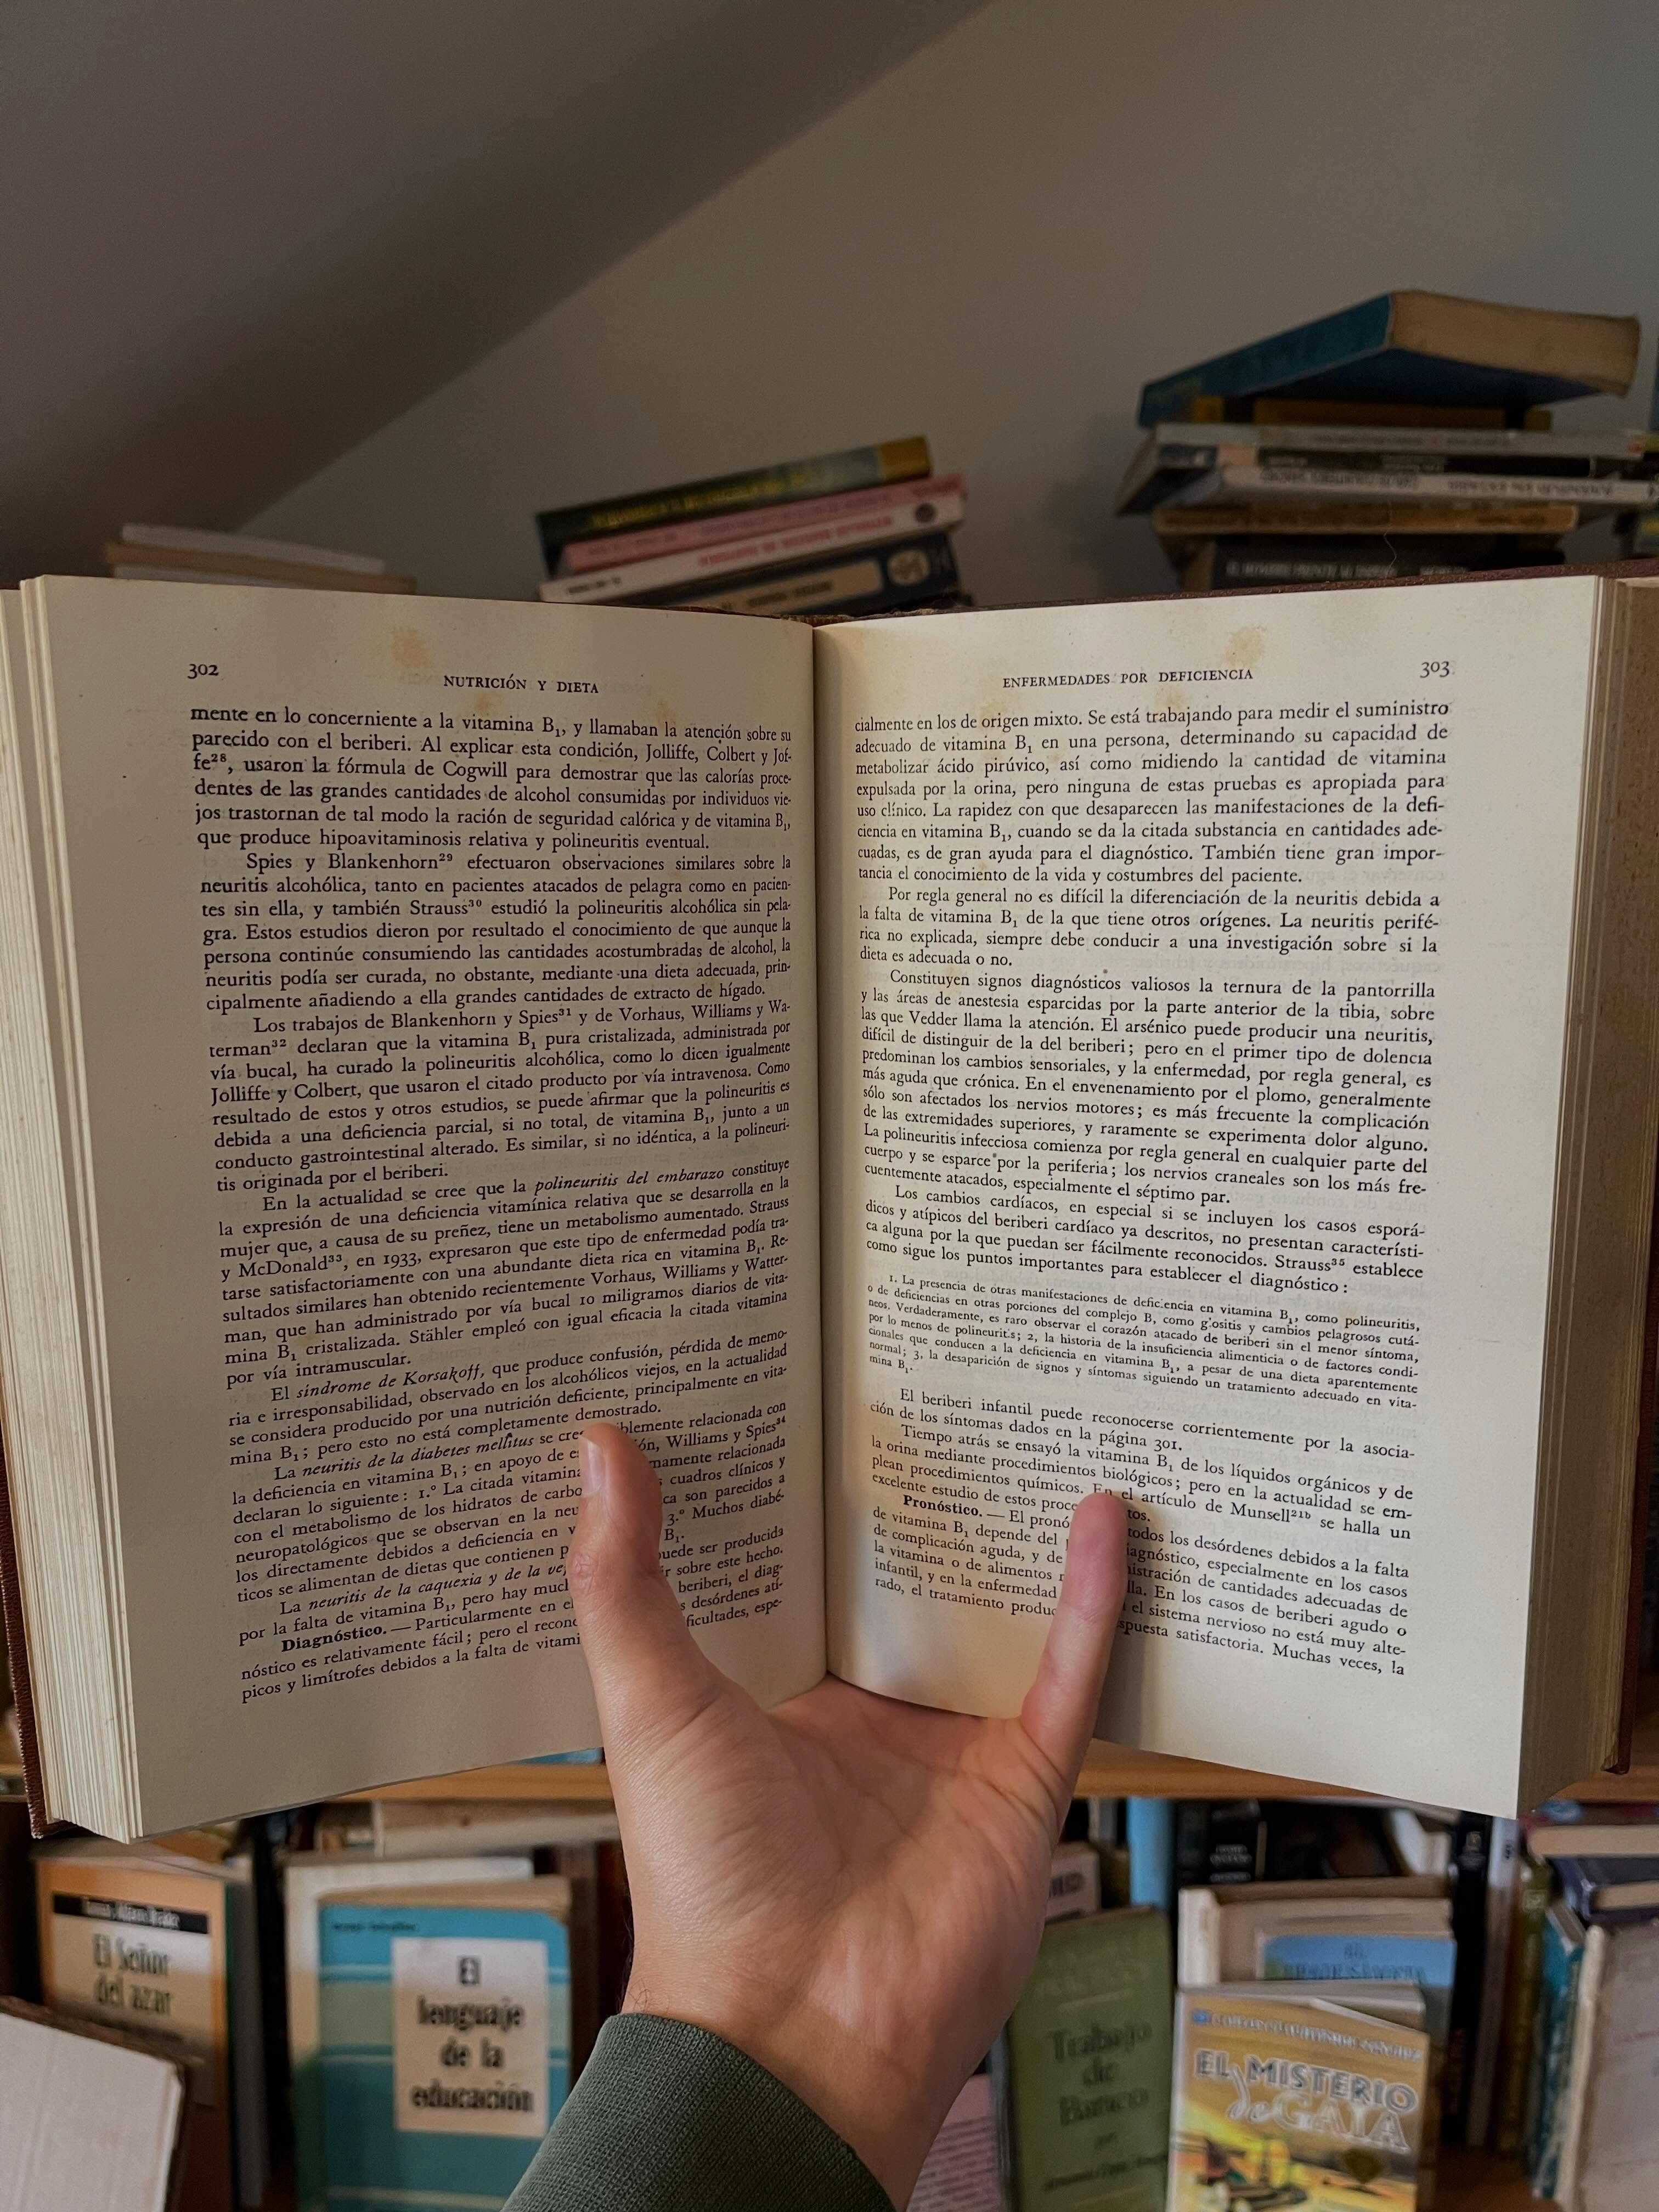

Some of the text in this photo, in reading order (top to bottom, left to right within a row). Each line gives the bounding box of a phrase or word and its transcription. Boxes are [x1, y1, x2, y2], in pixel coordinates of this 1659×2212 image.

[188, 664, 219, 679] 302
[444, 674, 599, 693] NUTRICIÓN Y DIETA
[1003, 669, 1253, 688] ENFERMEDADES POR DEFICIENCIA
[1420, 661, 1449, 678] 303
[198, 828, 709, 853] que produce hipoavitaminosis relativa y polineuritis eventual.
[859, 866, 1301, 888] tancia el conocimiento de la vida y costumbres del paciente.
[203, 917, 791, 946] gra. Estos estudios dieron por resultado el conocimiento de que aunque la
[860, 946, 1012, 966] dieta es adecuada o no.
[207, 980, 765, 1015] cipalmente añadiendo a ella grandes cantidades de extracto de hígado.
[890, 969, 1435, 1002] Constituyen signos diagnósticos valiosos la ternura de la pantorrilla
[217, 1163, 448, 1193] tis originada por el beriberi.
[262, 1160, 789, 1211] En la actualidad se cree que la polineuritis del embarazo constituye
[867, 1241, 896, 1252] como
[903, 1243, 935, 1260] sigue
[942, 1246, 959, 1260] los
[967, 1254, 1012, 1266] puntos
[1019, 1253, 1104, 1272] importantes
[1111, 1265, 1142, 1278] para
[1150, 1266, 1222, 1282] establecer
[1229, 1271, 1242, 1284] el
[869, 1300, 890, 1310] neos.
[896, 1302, 983, 1323] Verdaderamente,
[1035, 1317, 1080, 1330] observar
[1087, 1322, 1096, 1332] el
[1103, 1325, 1146, 1336] corazón
[1154, 1330, 1197, 1341] atacado
[1204, 1333, 1218, 1343] de
[1224, 1334, 1269, 1348] beriberi
[1277, 1340, 1294, 1350] sin
[1301, 1342, 1311, 1352] el
[1318, 1346, 1357, 1356] menor
[1365, 1347, 1418, 1363] síntoma,
[227, 1351, 411, 1390] por vía intramuscular.
[270, 1386, 290, 1402] El
[377, 1374, 397, 1387] de
[402, 1364, 485, 1386] Korsakoff,
[492, 1363, 519, 1379] que
[526, 1353, 583, 1375] produce
[589, 1344, 662, 1362] confusión,
[670, 1338, 721, 1360] pérdida
[727, 1335, 743, 1348] de
[748, 1330, 787, 1346] memo-
[871, 1401, 1182, 1452] ción de los síntomas dados en la página 301.
[876, 1578, 1003, 1609] rado, el tratamiento
[242, 1640, 529, 1703] picos y limítrofes debidos a la falta de
[459, 1956, 480, 1985] El
[417, 1995, 525, 2033] lenguaje
[441, 2035, 504, 2068] de la
[411, 2080, 534, 2113] educación
[1195, 2050, 1419, 2113] EL MISTERIO
